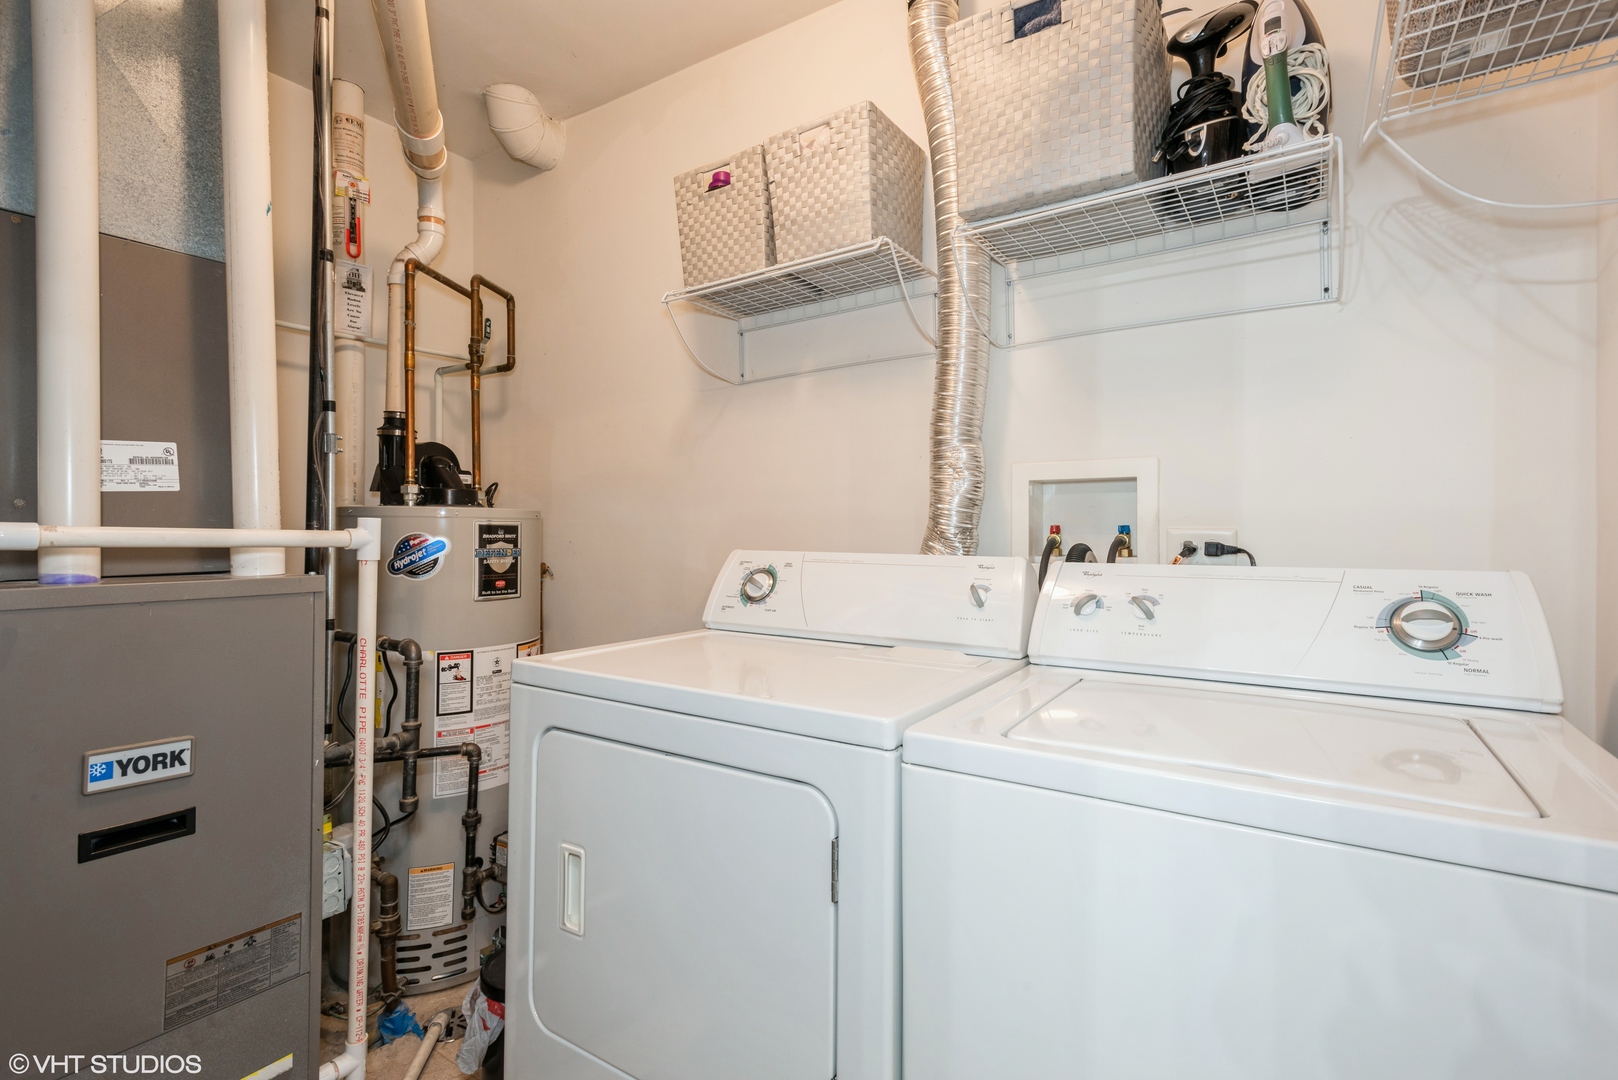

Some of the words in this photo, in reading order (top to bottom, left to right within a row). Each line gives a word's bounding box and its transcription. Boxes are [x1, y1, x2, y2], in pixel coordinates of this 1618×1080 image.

[394, 548, 426, 569] Hydrojet
[476, 548, 521, 558] DEFENDER
[116, 748, 186, 777] YORK
